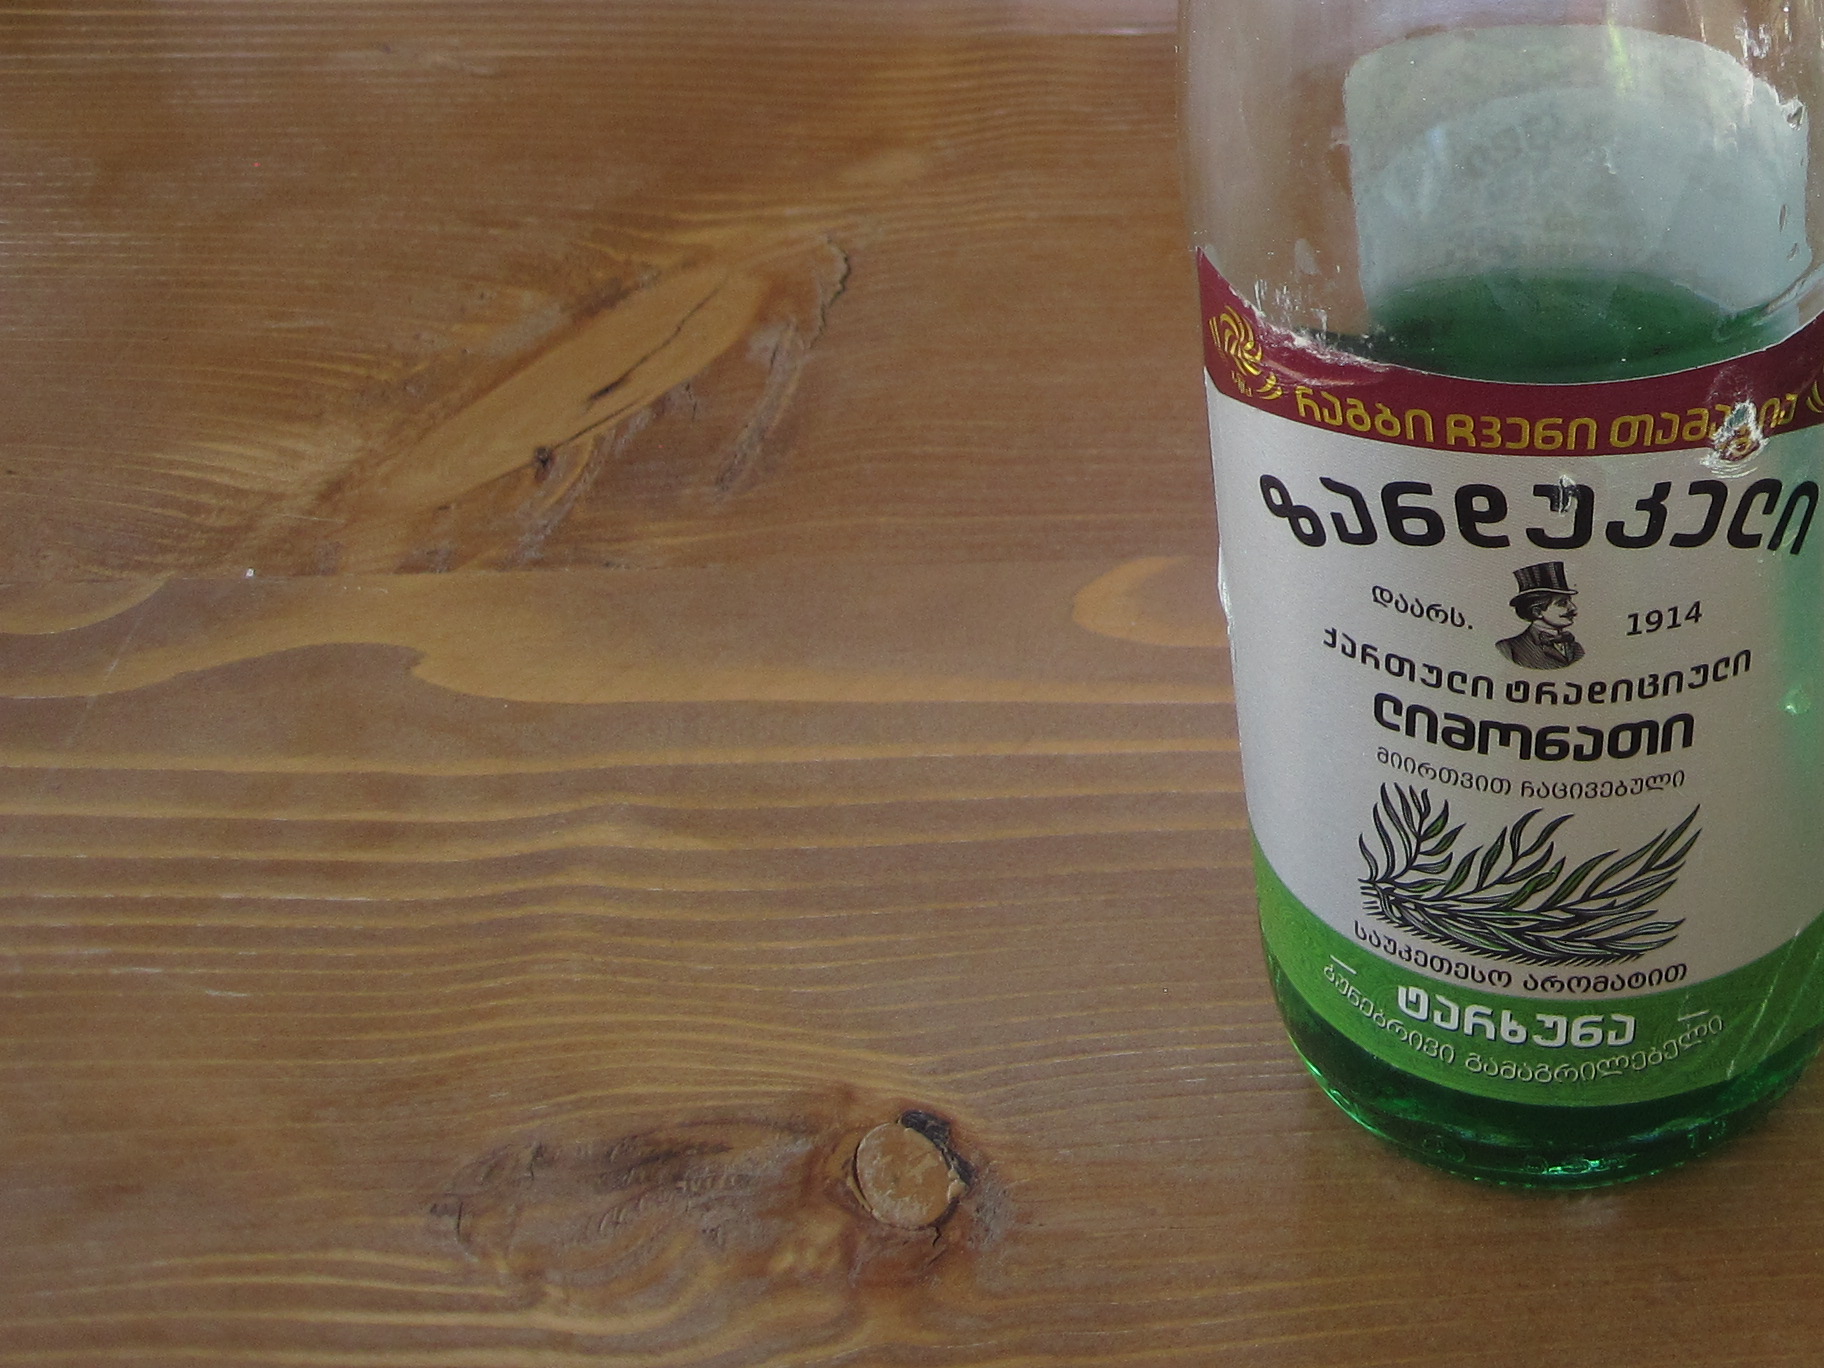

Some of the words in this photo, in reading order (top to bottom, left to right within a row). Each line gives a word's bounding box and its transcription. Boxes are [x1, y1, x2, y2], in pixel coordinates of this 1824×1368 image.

[1295, 385, 1434, 443] რაგბი
[1446, 413, 1598, 451] ჩვენი
[1259, 474, 1819, 555] ზანდუკელი
[1371, 585, 1474, 630] დაარს.
[1625, 601, 1702, 636] 1914
[1323, 627, 1495, 700] ქართული
[1505, 648, 1751, 706] ტრადიციული
[1374, 692, 1695, 762] ლიმონათი
[1376, 746, 1512, 796] მიირთვით
[1353, 920, 1512, 988] საუკეთესო
[1523, 963, 1687, 994] არომატით
[1323, 963, 1456, 1065] ბუნებრივი
[1464, 1015, 1724, 1084] გამაგრილებელი
[1397, 985, 1637, 1049] ტარხუნა
